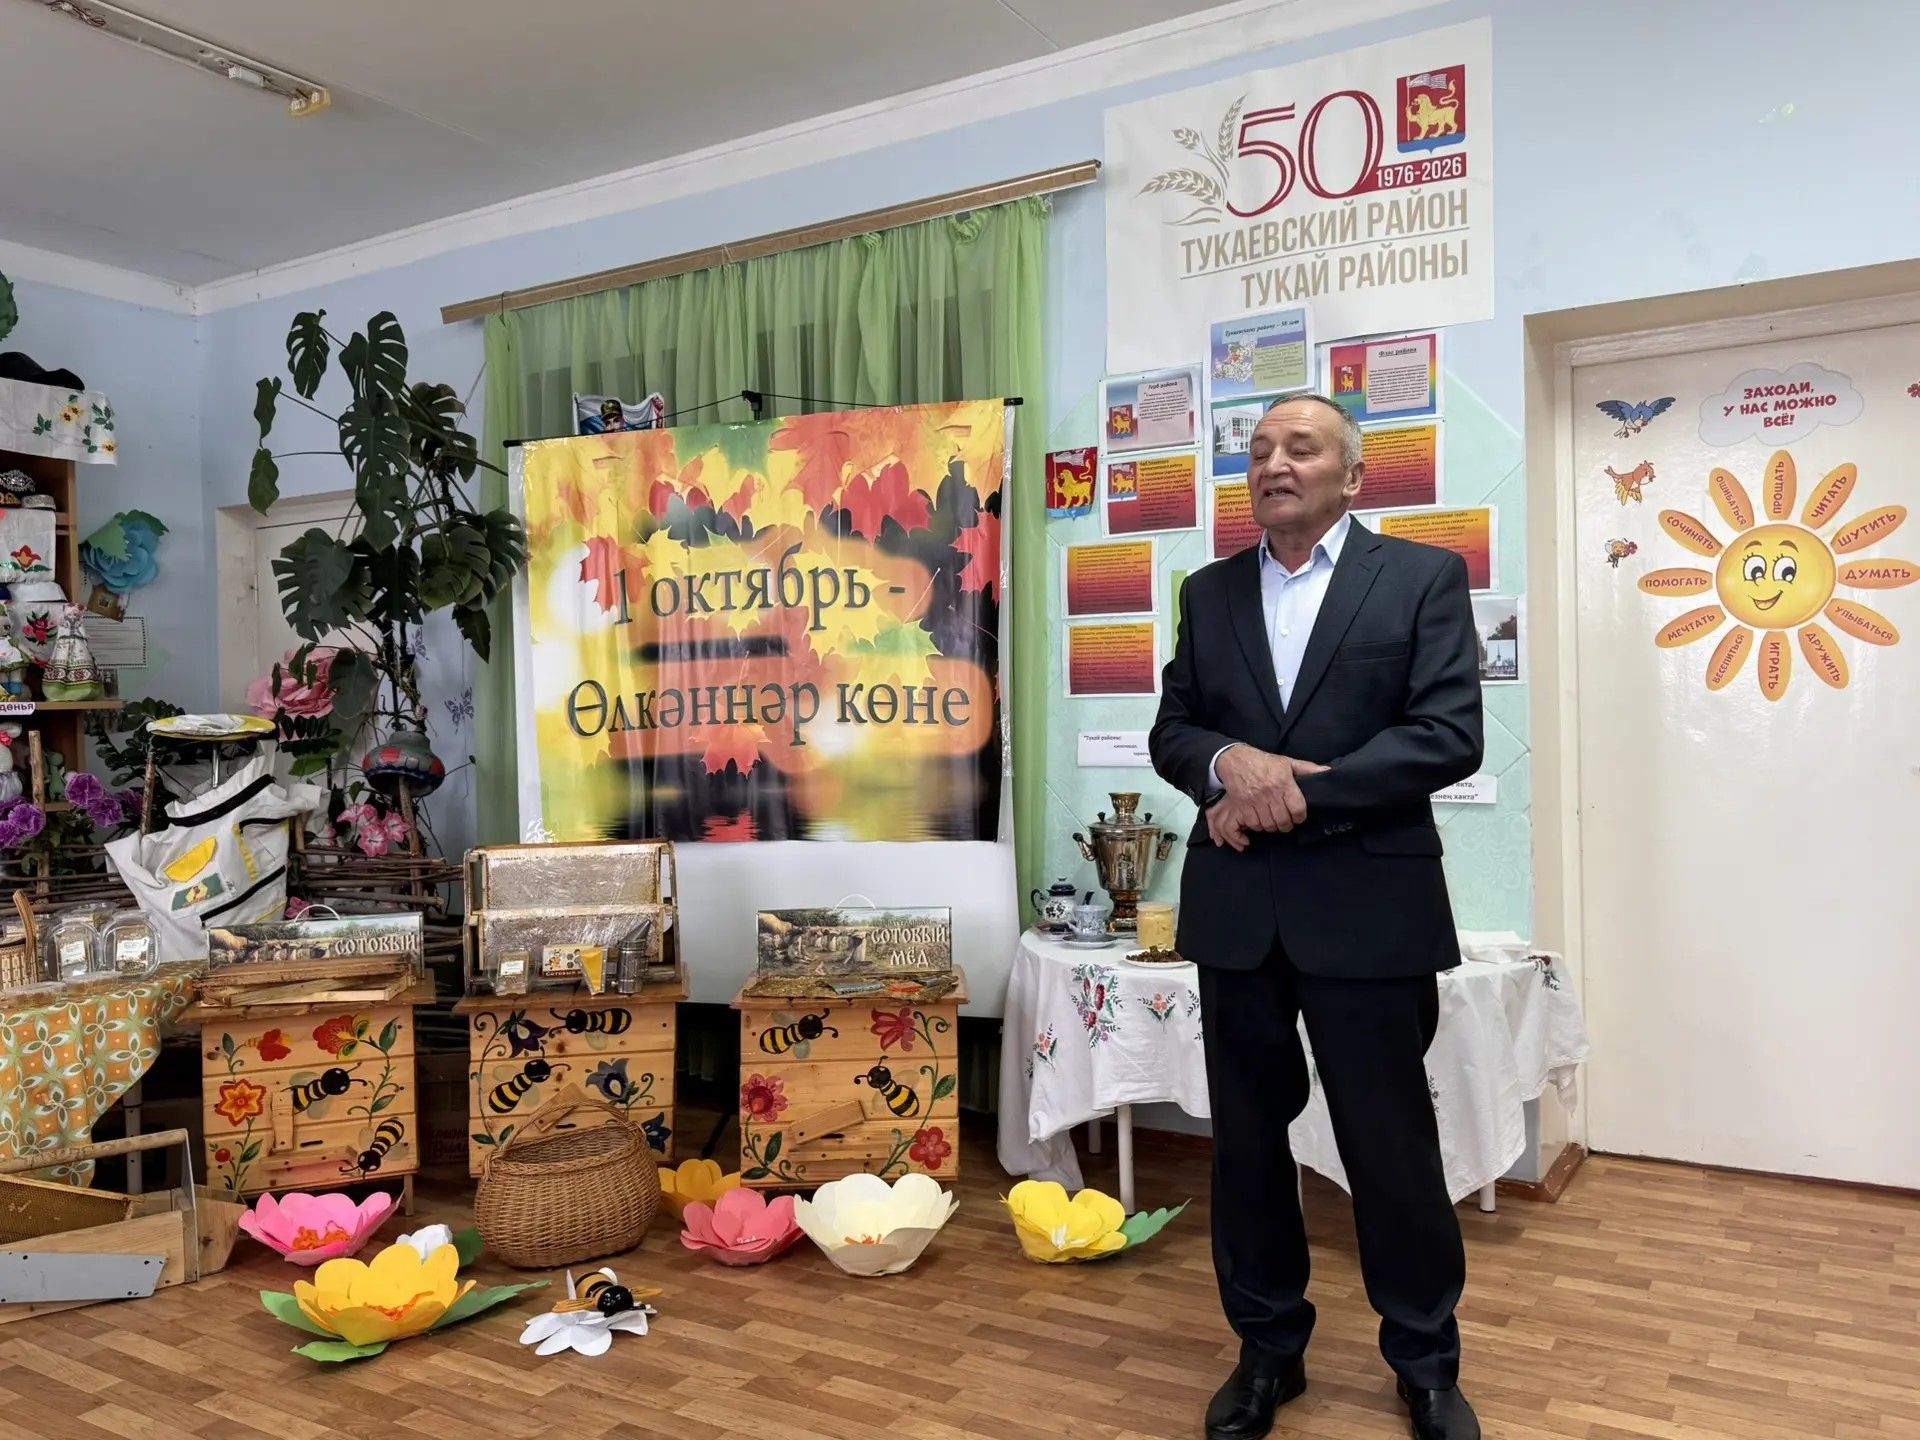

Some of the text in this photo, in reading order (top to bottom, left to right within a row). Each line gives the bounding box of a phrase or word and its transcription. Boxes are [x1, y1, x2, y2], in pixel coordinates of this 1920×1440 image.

[1226, 90, 1384, 218] 50
[1376, 158, 1462, 188] 1976-2026
[1181, 188, 1468, 274] ТУКАЕВСКИЙ РАЙОН
[1241, 239, 1469, 309] ТУКАЙ РАЙОНЫ
[1723, 394, 1837, 417] У НАС МОЖНО
[1743, 381, 1814, 400] ЗАХОДИ,
[1763, 412, 1795, 428] ВСЁ!
[1715, 475, 1747, 526] ОШИБАТЬСЯ
[1773, 461, 1785, 514] ПРОЩАТЬ
[1811, 475, 1847, 519] ЧИТАТЬ
[1666, 516, 1714, 550] СОЧИНЯТЬ
[1837, 512, 1897, 547] ШУТИТЬ
[612, 567, 633, 625] 1
[650, 546, 871, 632] октябрь
[1645, 576, 1708, 588] ПОМОГАТЬ
[1845, 568, 1911, 580] ДУМАТЬ
[1667, 613, 1716, 641] МЕЧТАТЬ
[1768, 641, 1780, 690] ИГРАТЬ
[1805, 632, 1842, 683] ДРУЖИТЬ
[567, 678, 972, 747] Өлкәннәр көне
[335, 931, 419, 956] СОТОВЫЙ
[871, 924, 948, 945] СОТОВЫЙ
[889, 945, 929, 968] МЁД
